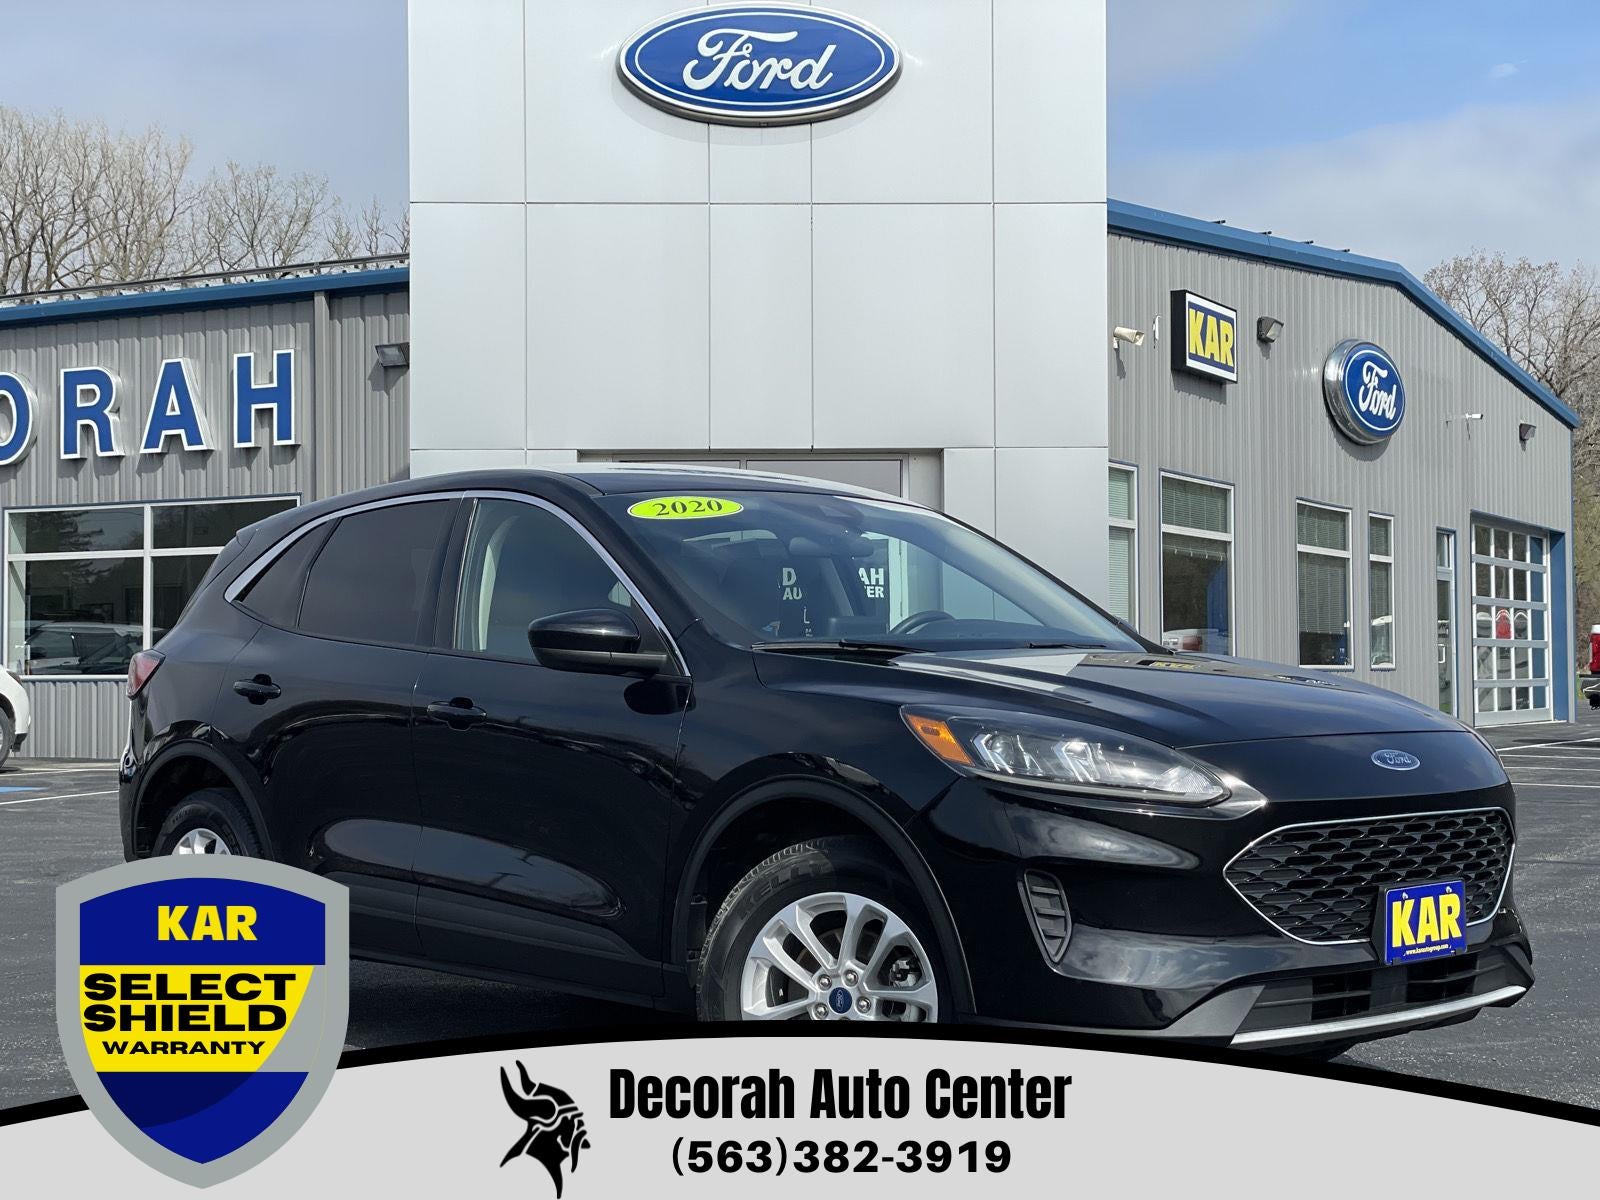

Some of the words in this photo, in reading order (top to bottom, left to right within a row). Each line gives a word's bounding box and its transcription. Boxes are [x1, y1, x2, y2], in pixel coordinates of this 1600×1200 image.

[682, 28, 837, 90] Ford
[1188, 308, 1235, 367] KAR
[1358, 360, 1398, 421] Ford
[652, 499, 723, 517] 2020
[1383, 751, 1412, 765] Ford
[1391, 893, 1463, 948] KAR
